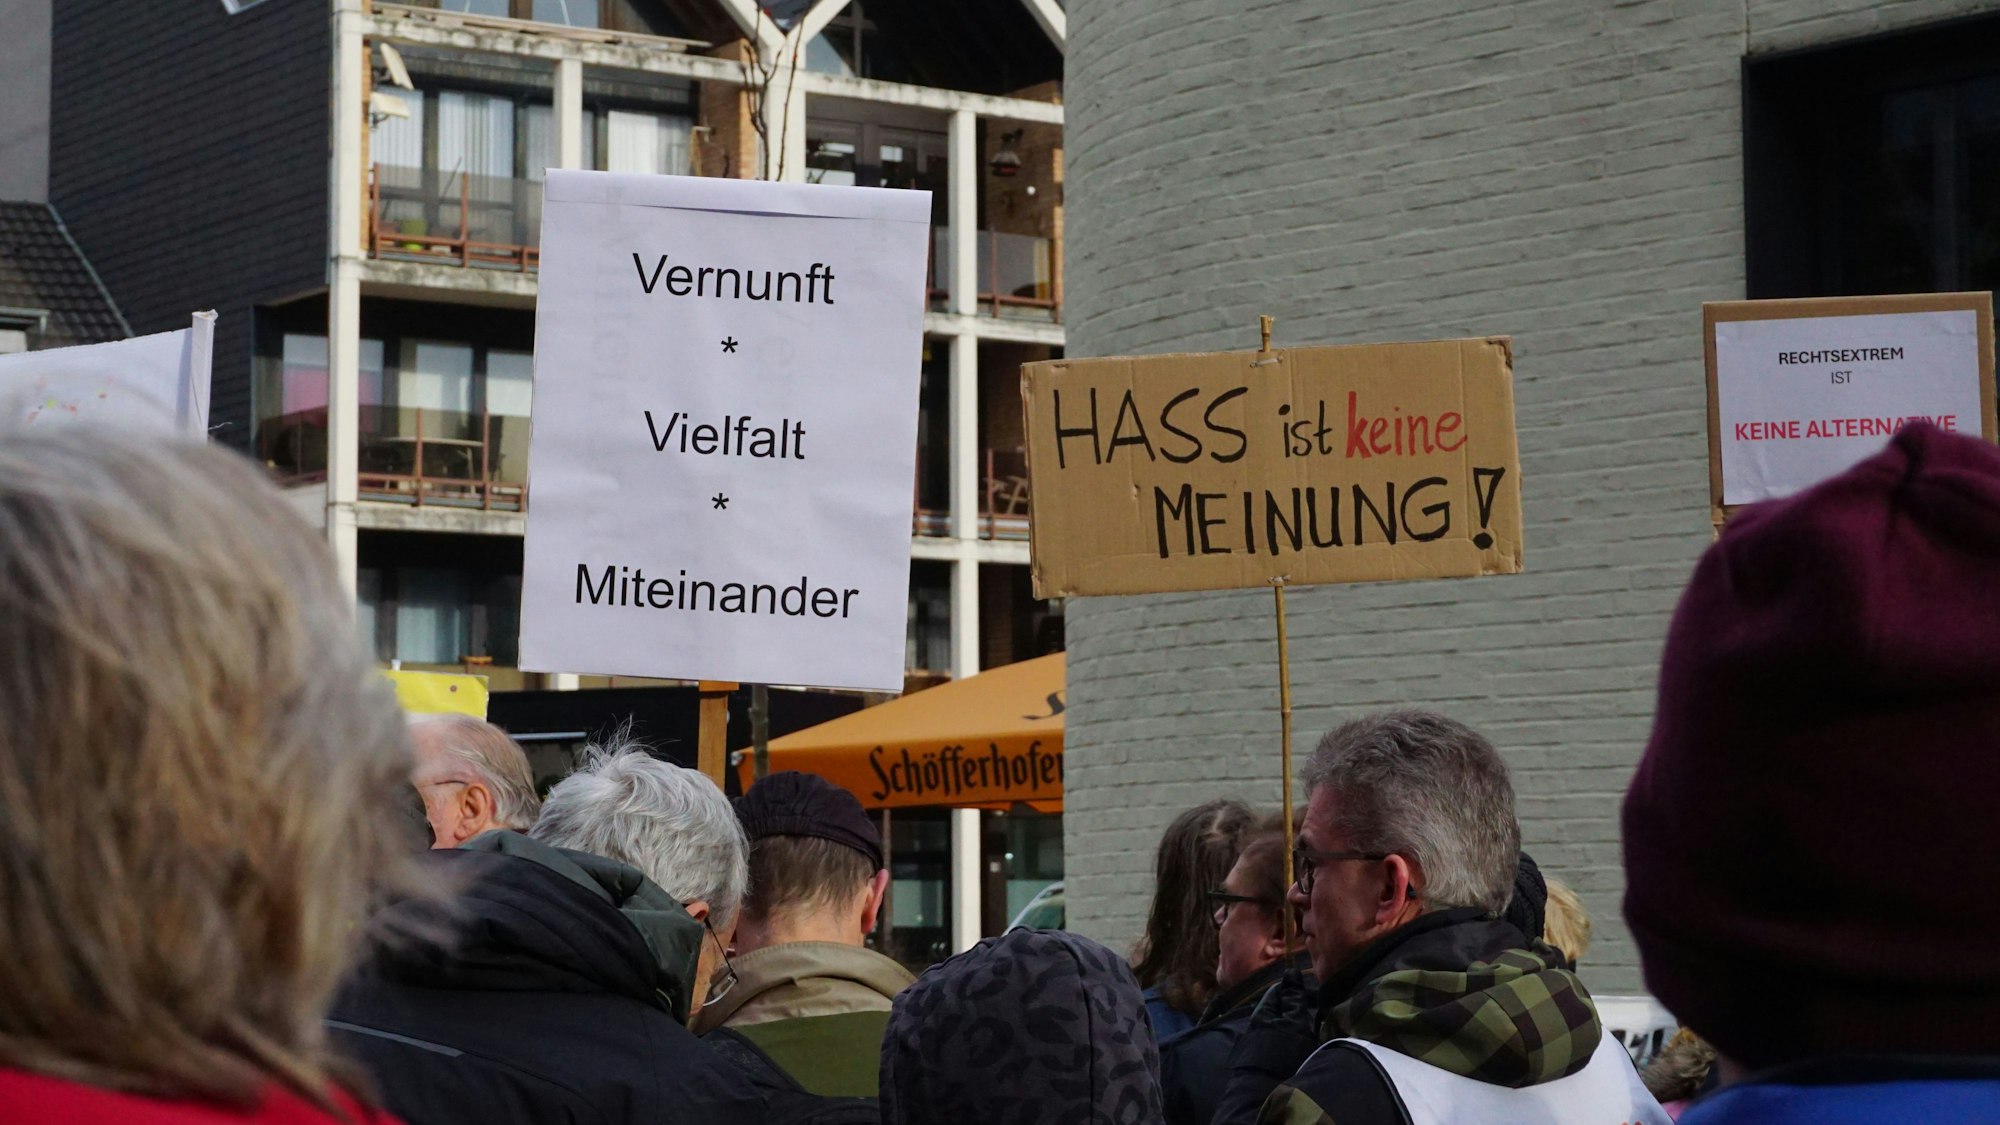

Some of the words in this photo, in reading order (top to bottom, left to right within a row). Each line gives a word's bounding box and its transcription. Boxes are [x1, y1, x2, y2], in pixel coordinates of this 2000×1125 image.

[633, 253, 835, 304] Vernunft
[1778, 346, 1904, 366] RECHTSEXTREM
[1830, 370, 1853, 385] IST
[644, 411, 806, 460] Vielfalt
[1053, 387, 1249, 469] HASS
[1278, 400, 1333, 459] ist
[1346, 391, 1467, 459] keine
[1735, 421, 1801, 441] KEINE
[1806, 414, 1957, 439] ALTERNAVE
[576, 563, 860, 618] Miteinander
